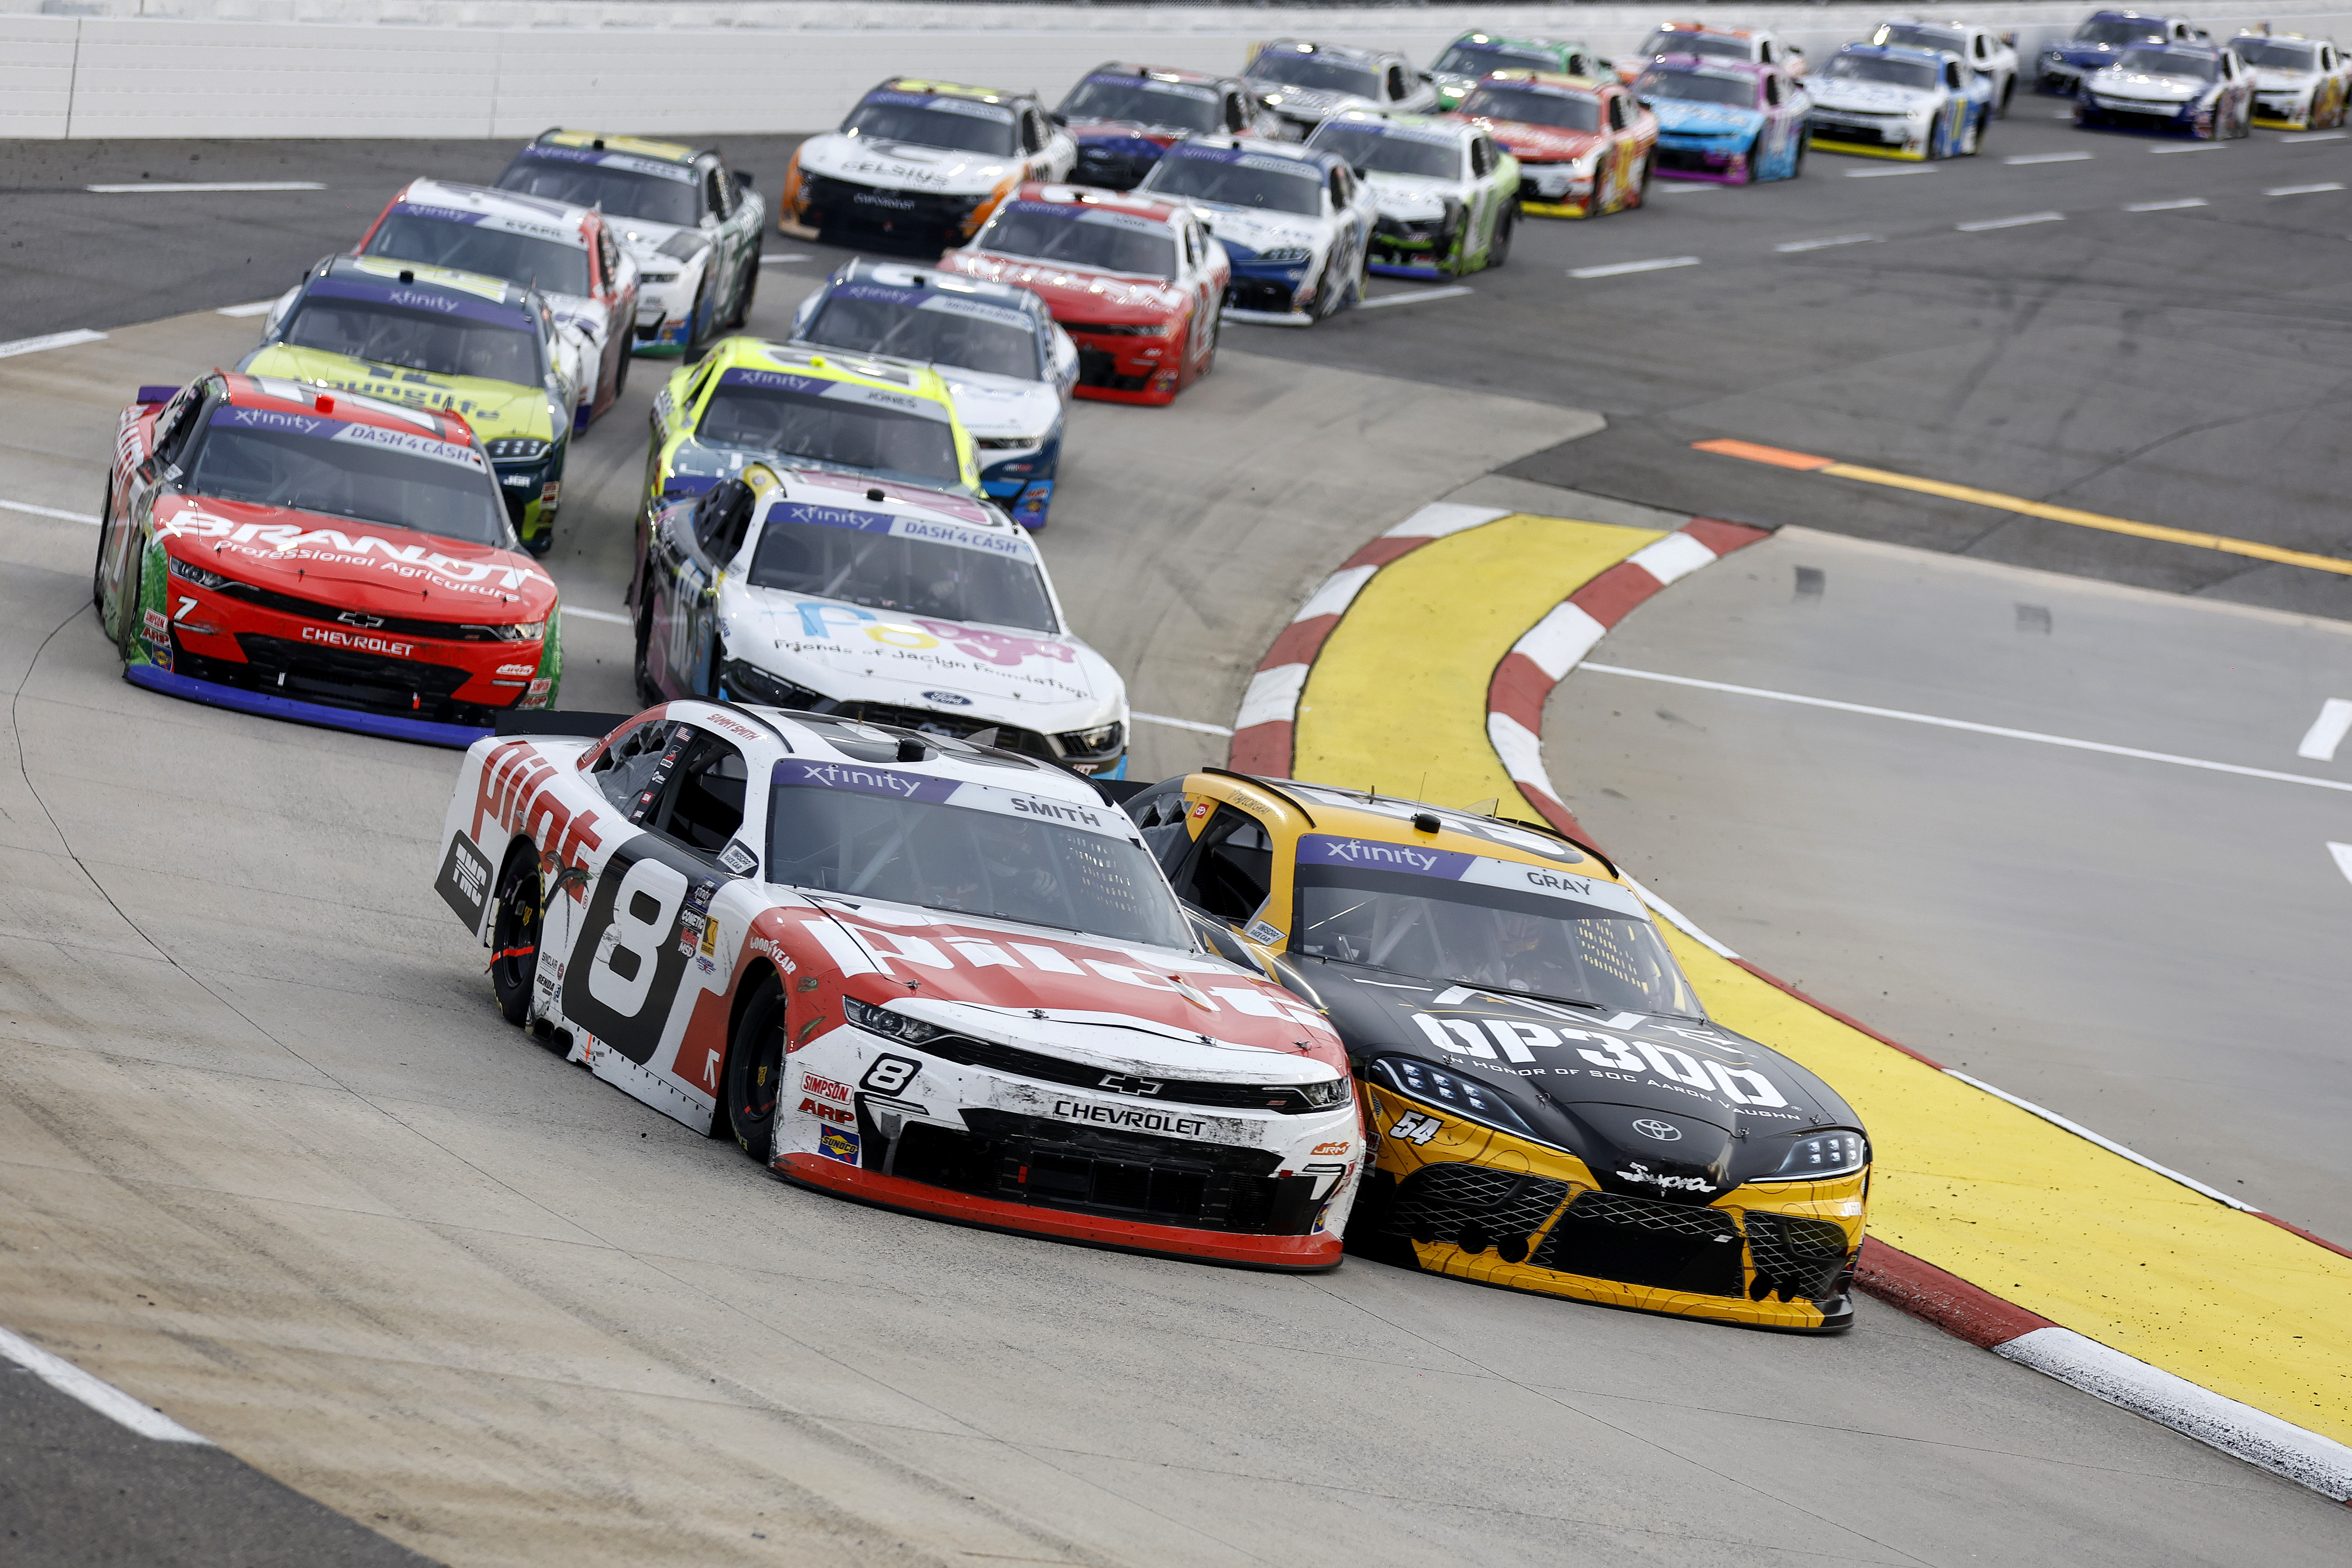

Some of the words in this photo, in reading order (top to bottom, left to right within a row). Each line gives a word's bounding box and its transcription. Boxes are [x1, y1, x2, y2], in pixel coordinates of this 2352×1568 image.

[389, 290, 459, 313] xfinity
[740, 370, 810, 389] xfinity
[868, 390, 917, 409] JONES
[234, 409, 320, 433] xfinity
[351, 426, 401, 446] DASH
[407, 439, 418, 450] 4
[421, 442, 469, 462] CASH
[790, 507, 874, 529] xfinity
[152, 510, 555, 590] BRANDT
[904, 522, 953, 541] DASH
[958, 532, 968, 543] 4
[972, 534, 1018, 554] CASH
[215, 540, 376, 567] Professional
[381, 561, 520, 602] Agriculture
[174, 596, 198, 621] 7
[143, 627, 169, 644] ARP
[302, 627, 414, 657] CHEVROLET
[774, 639, 853, 655] Friends
[892, 650, 966, 669] Jaclyn
[973, 662, 1088, 699] Foundation
[933, 691, 963, 705] Ford
[706, 714, 740, 729] SAMMY
[730, 725, 761, 741] SMITH
[804, 764, 921, 797] xfinity
[1010, 798, 1101, 827] SMITH
[1325, 840, 1437, 871] xfinity
[1527, 872, 1591, 895] GRAY
[589, 857, 689, 1018] 8
[678, 942, 694, 957] MSD
[803, 1073, 849, 1103] SIMPSON
[867, 1058, 914, 1091] 8
[1473, 1061, 1547, 1077] HONOR
[1555, 1068, 1580, 1076] OF
[1589, 1069, 1637, 1083] SOC
[1647, 1079, 1713, 1102] AARON
[1718, 1099, 1802, 1121] VAUGHN
[799, 1097, 855, 1125] ARP
[1055, 1100, 1206, 1136] CHEVROLET
[1389, 1110, 1443, 1147] 54
[821, 1135, 858, 1154] SUNOCO
[1313, 1146, 1346, 1156] JRM
[1840, 1201, 1863, 1217] JGR
